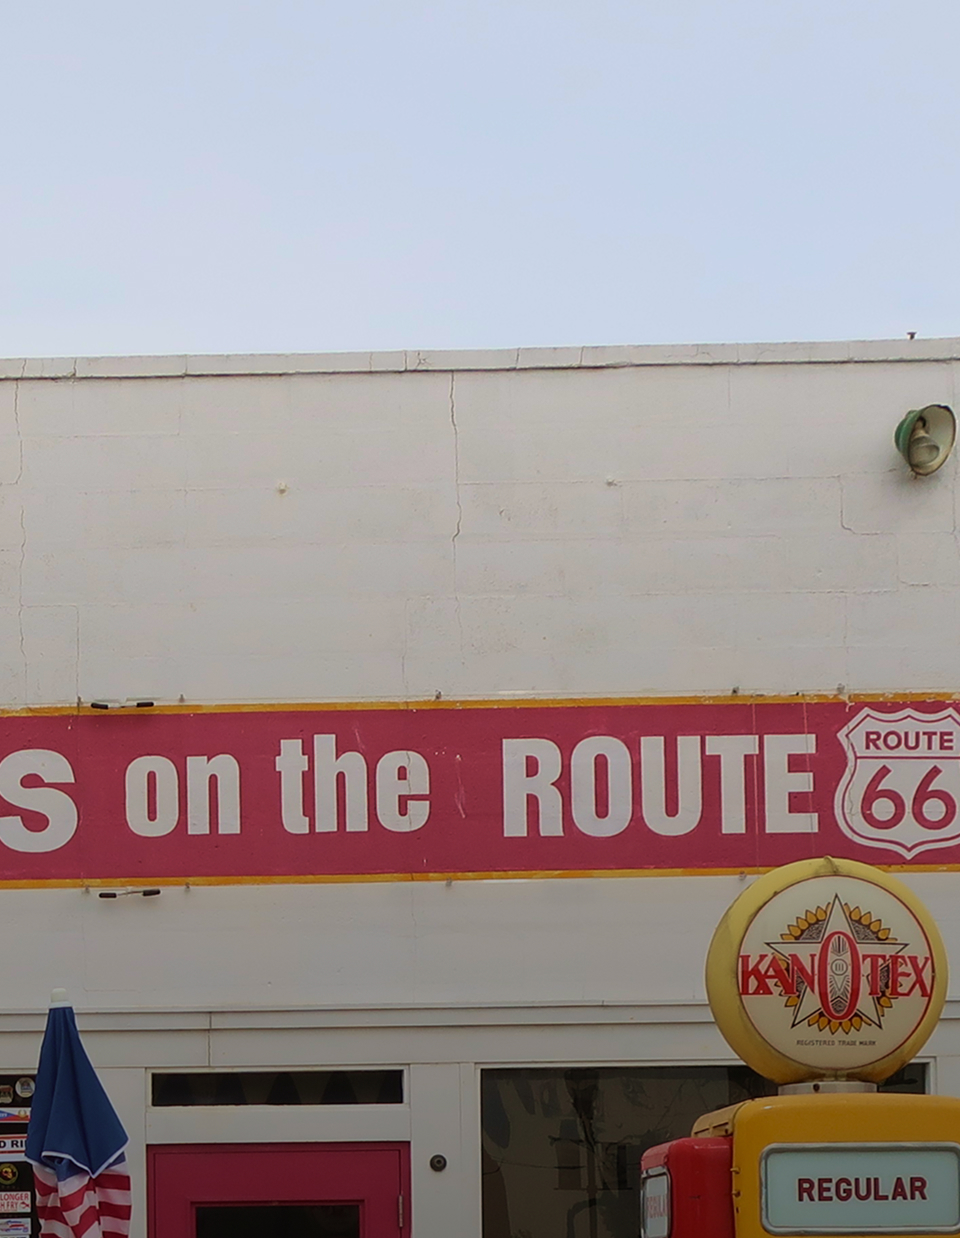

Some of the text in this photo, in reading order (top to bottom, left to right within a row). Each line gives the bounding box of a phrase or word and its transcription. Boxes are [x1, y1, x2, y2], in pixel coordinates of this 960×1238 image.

[863, 730, 955, 753] ROUTE
[123, 750, 242, 838] on
[275, 733, 432, 834] the
[501, 733, 820, 839] ROUTE
[860, 765, 958, 832] 66
[0, 1193, 29, 1201] LONGER
[797, 1177, 928, 1201] REGULAR
